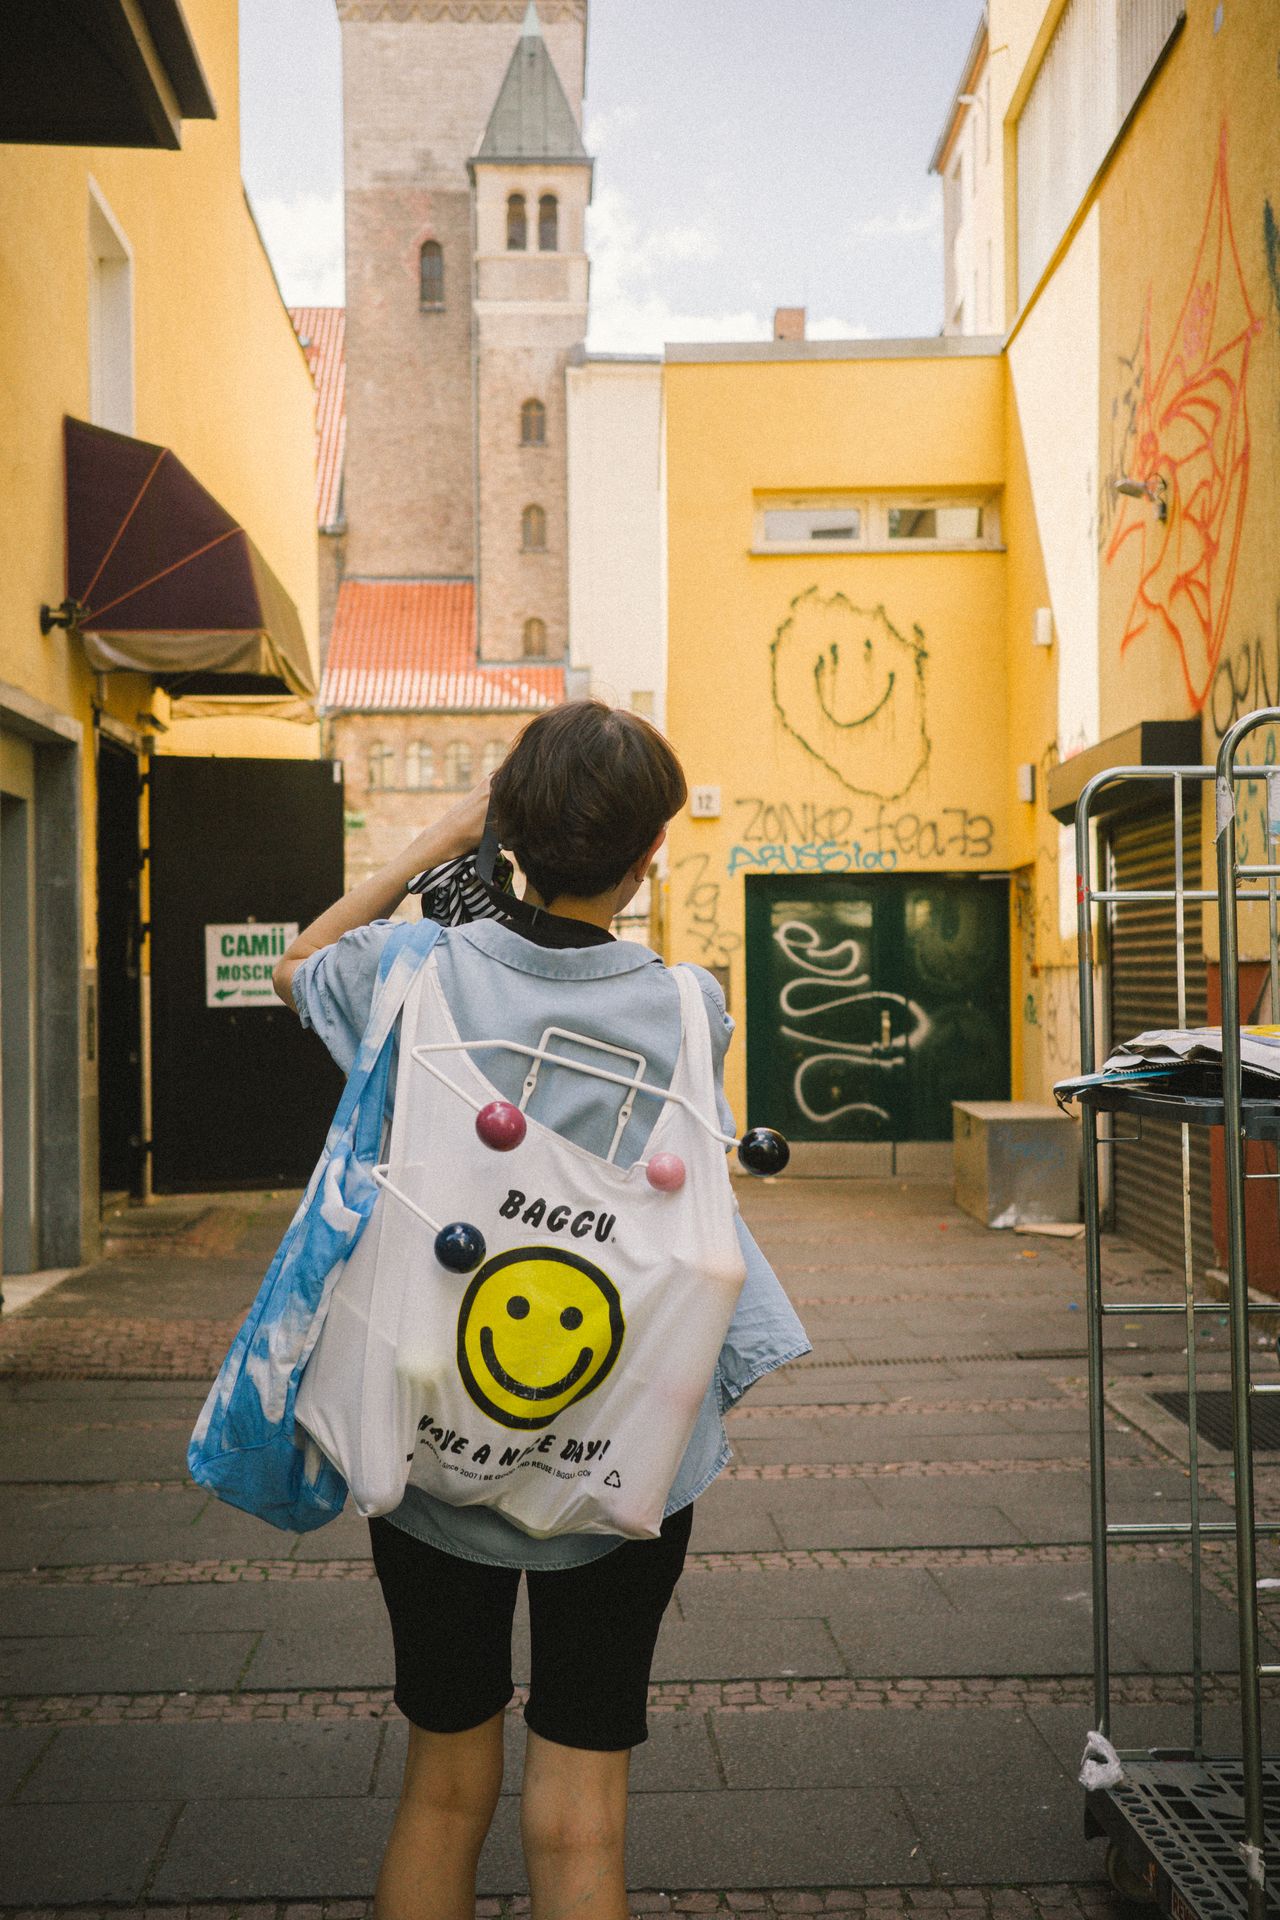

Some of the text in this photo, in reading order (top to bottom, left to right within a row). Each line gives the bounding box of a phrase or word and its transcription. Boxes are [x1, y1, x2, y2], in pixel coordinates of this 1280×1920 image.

[216, 964, 273, 981] MOSCH
[472, 1443, 491, 1465] A
[499, 1434, 557, 1466] NE
[560, 1438, 612, 1465] DAY!
[459, 1468, 478, 1480] 2007
[531, 1460, 554, 1475] REUSE
